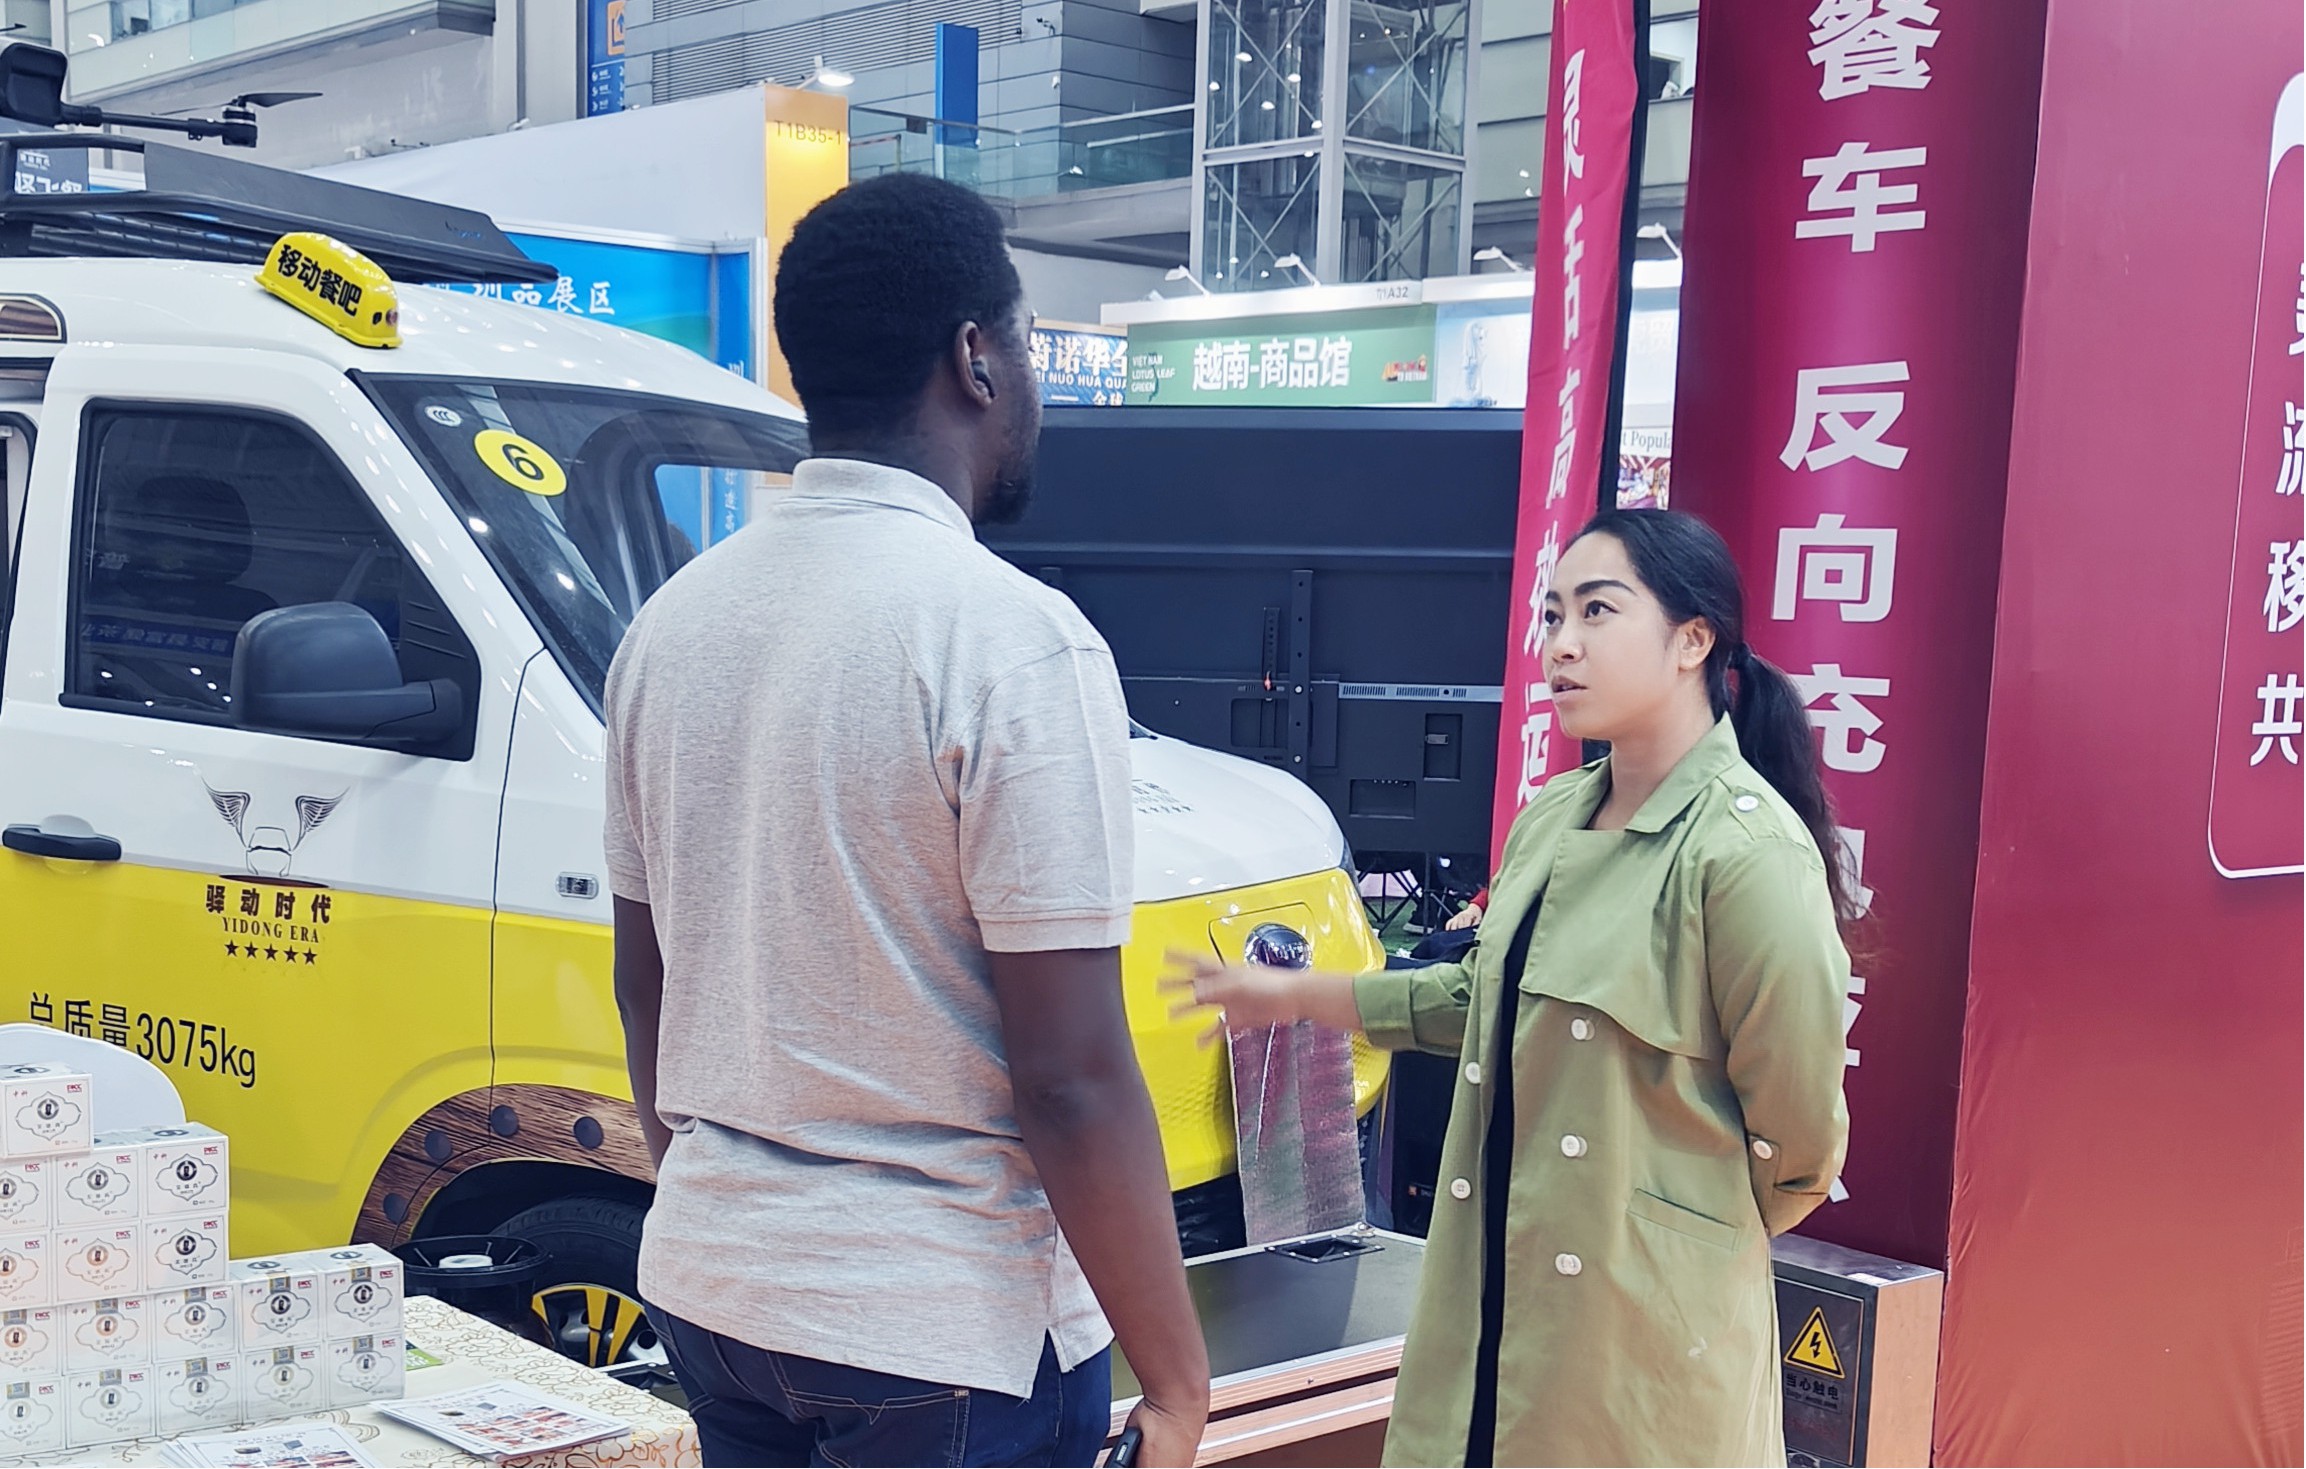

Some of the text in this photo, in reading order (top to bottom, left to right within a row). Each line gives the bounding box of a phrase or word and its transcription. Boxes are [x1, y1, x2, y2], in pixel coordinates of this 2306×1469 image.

[774, 120, 841, 145] T1B35-1
[278, 244, 362, 317] 移动餐吧
[1132, 367, 1175, 380] LOTUS LEAF
[1193, 335, 1352, 391] 越南-商品馆
[1049, 371, 1074, 385] NUO
[1078, 374, 1102, 388] HUA
[502, 443, 544, 481] 6
[2250, 673, 2305, 767] 共
[206, 884, 332, 924] 驿动时代
[222, 917, 319, 943] YIDONG ERA
[1786, 1373, 1839, 1400] 当心触电
